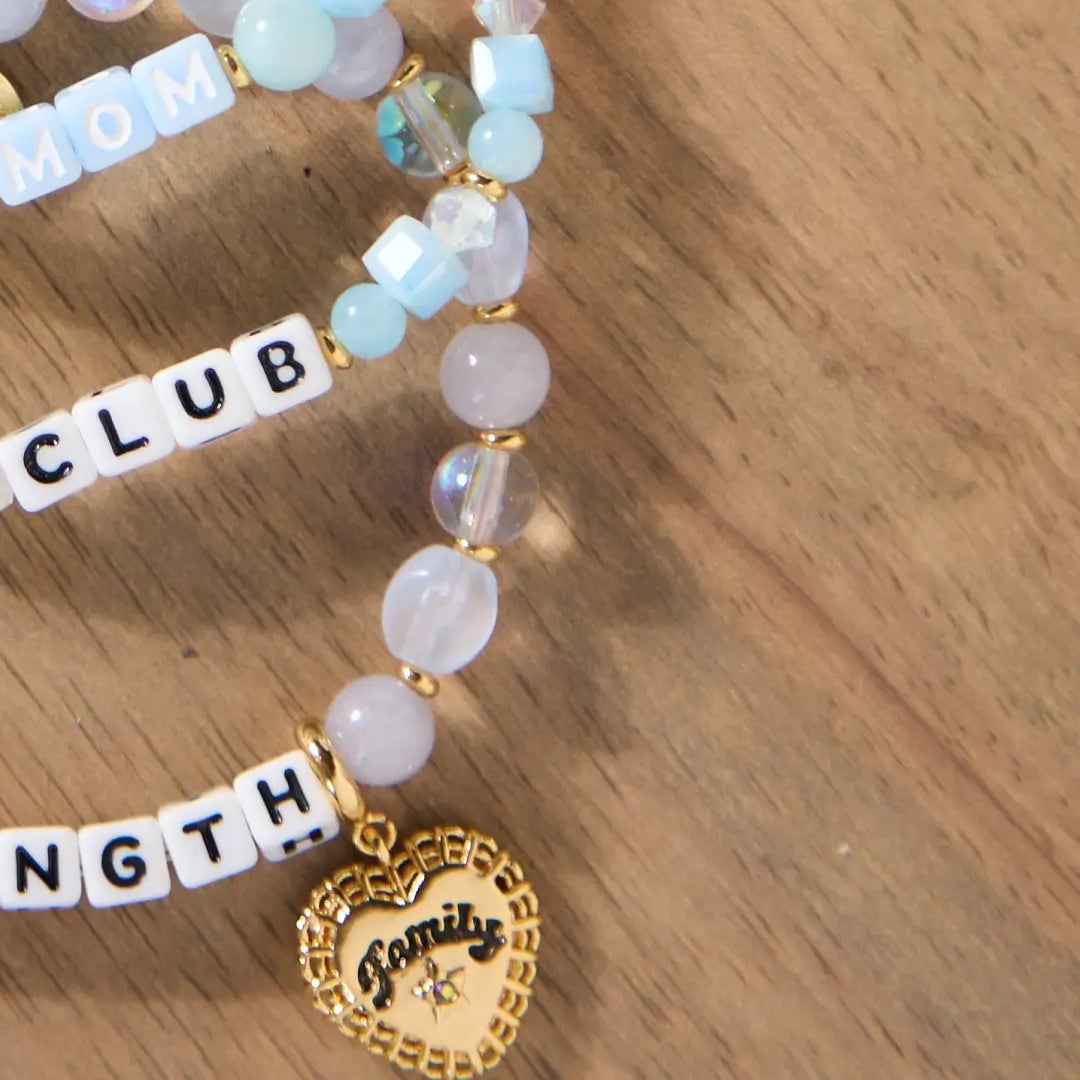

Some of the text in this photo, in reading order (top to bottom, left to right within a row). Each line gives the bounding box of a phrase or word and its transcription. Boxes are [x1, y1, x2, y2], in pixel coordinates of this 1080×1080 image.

[1, 50, 218, 193] MOM
[23, 340, 306, 484] CLUB
[357, 903, 508, 1011] Family
